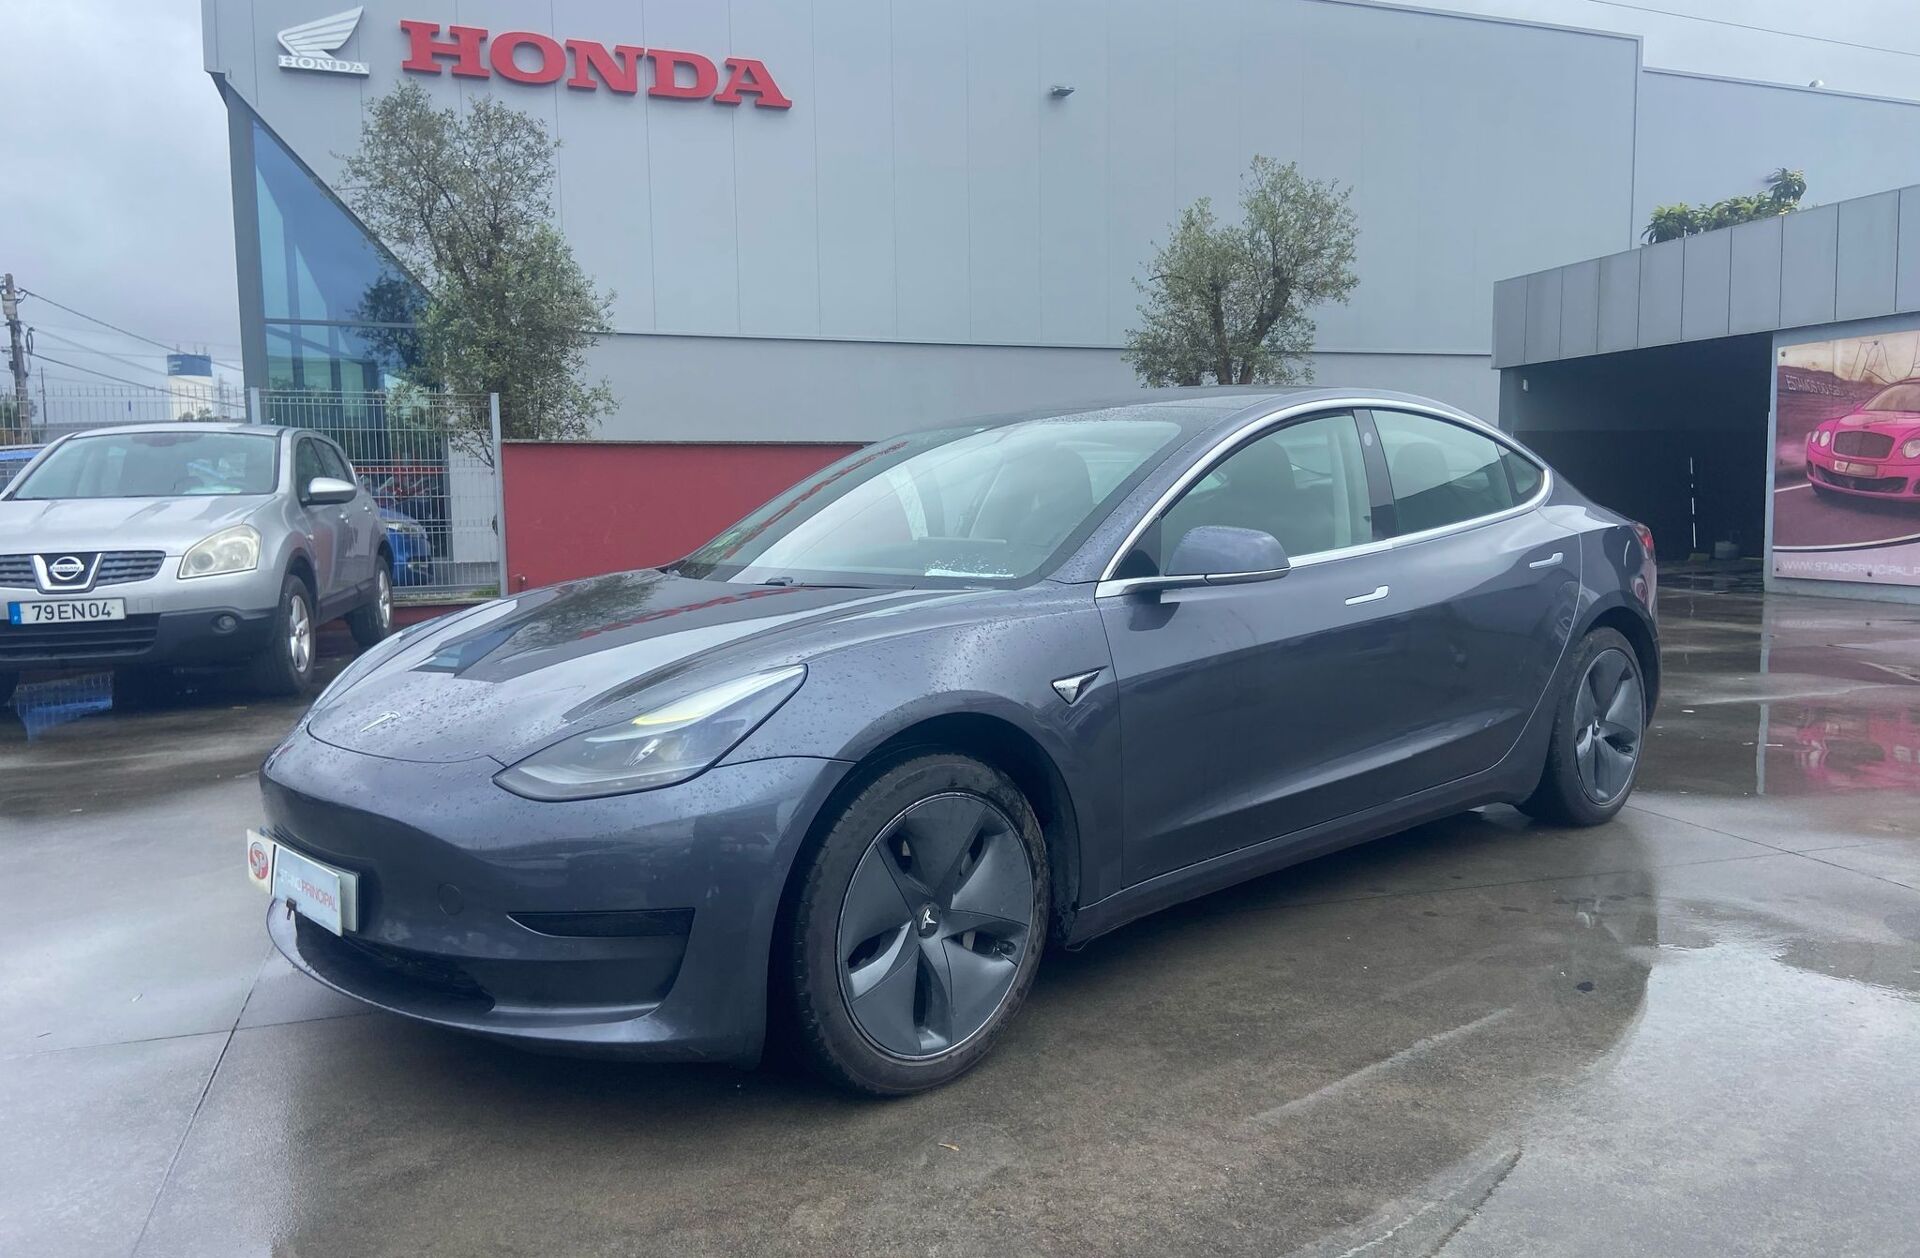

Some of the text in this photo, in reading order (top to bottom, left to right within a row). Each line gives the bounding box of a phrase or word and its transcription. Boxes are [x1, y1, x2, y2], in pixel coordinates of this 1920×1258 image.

[278, 55, 370, 75] HONDA
[400, 19, 793, 109] HONDA
[32, 602, 111, 620] 79EN04
